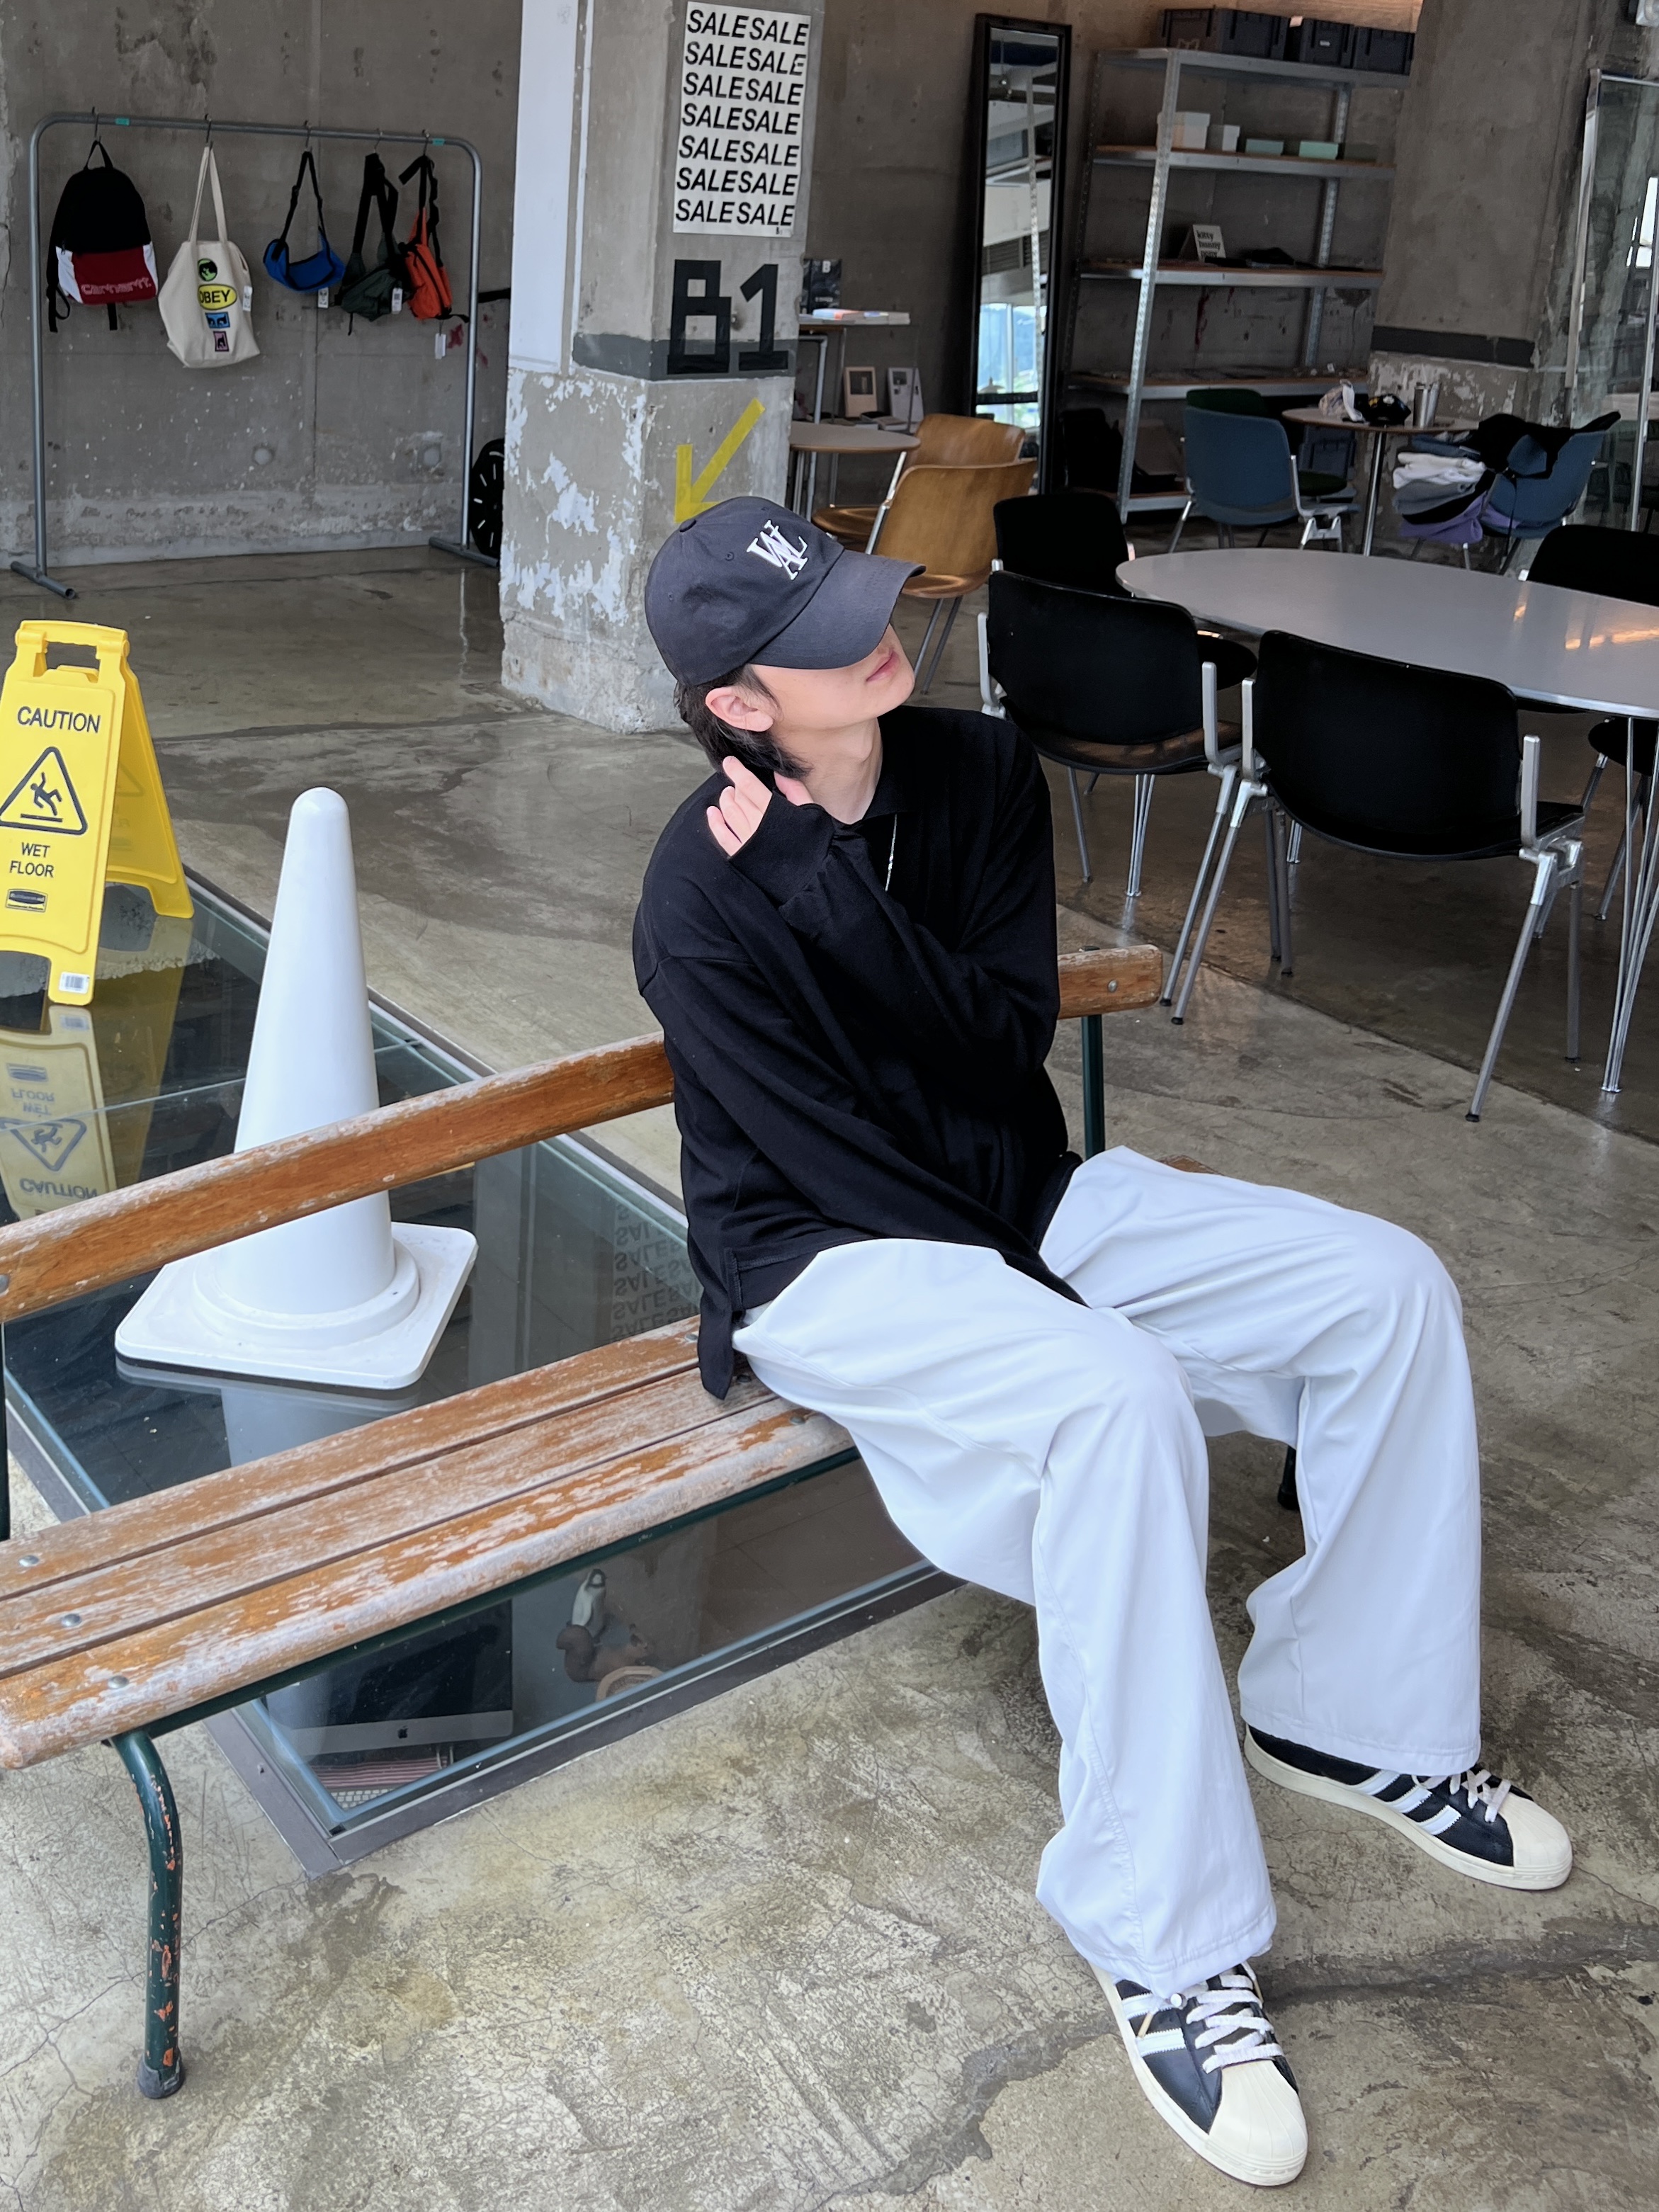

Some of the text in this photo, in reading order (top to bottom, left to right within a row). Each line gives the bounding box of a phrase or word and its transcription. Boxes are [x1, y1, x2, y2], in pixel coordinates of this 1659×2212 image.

[198, 289, 231, 304] OBEY
[18, 706, 101, 734] CAUTION
[21, 842, 50, 858] WET
[9, 860, 55, 878] FLOOR
